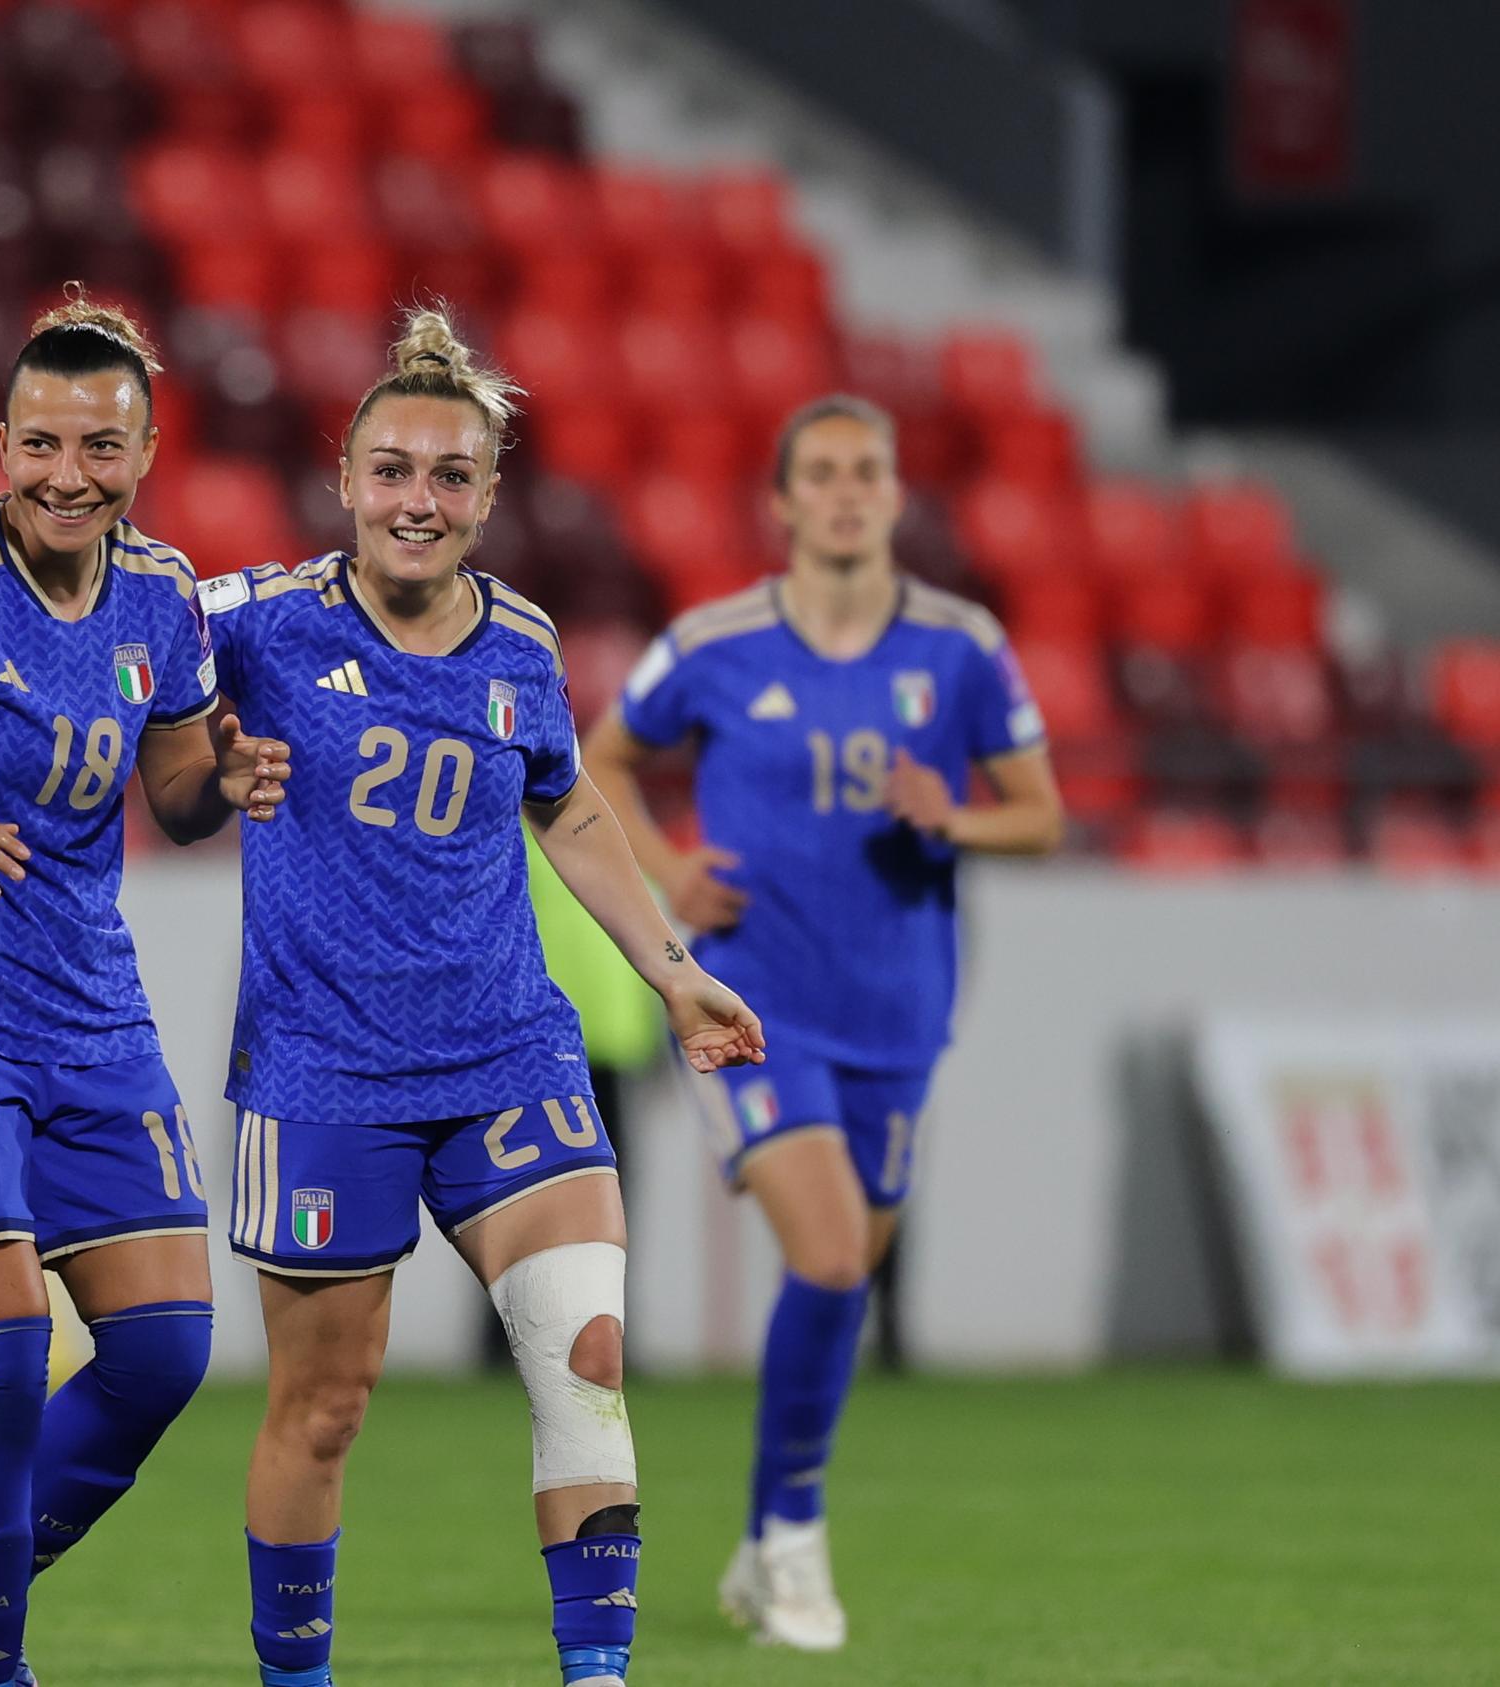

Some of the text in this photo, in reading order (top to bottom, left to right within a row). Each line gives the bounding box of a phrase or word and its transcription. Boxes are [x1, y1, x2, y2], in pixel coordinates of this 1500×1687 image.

[34, 714, 123, 810] 18
[349, 725, 475, 837] 20
[805, 730, 890, 815] 19
[483, 1095, 598, 1170] 20
[295, 1193, 330, 1206] ITALIA
